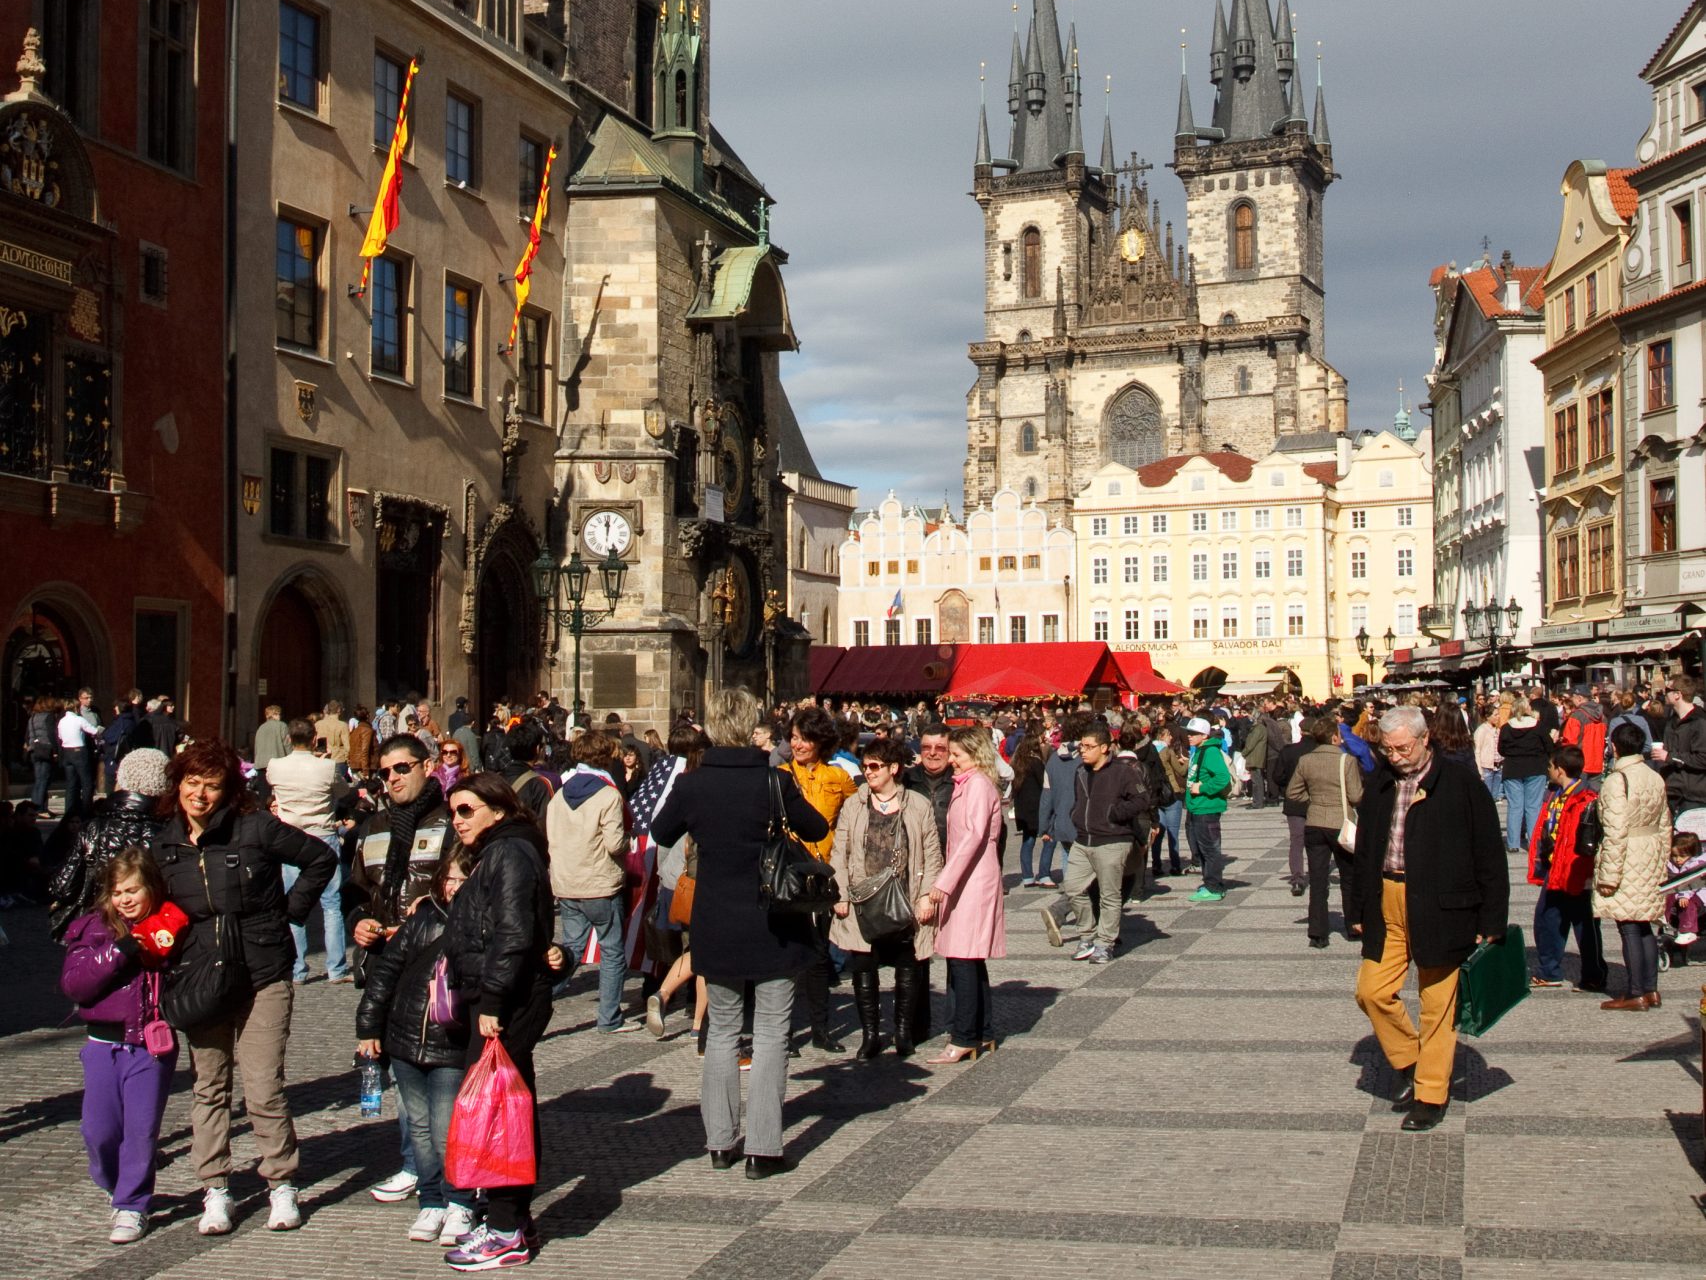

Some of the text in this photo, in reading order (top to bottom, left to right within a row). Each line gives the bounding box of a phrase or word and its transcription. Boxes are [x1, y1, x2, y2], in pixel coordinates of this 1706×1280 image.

[1115, 642, 1178, 652] ALFONS MUCHA
[1212, 640, 1258, 649] SALVADOR
